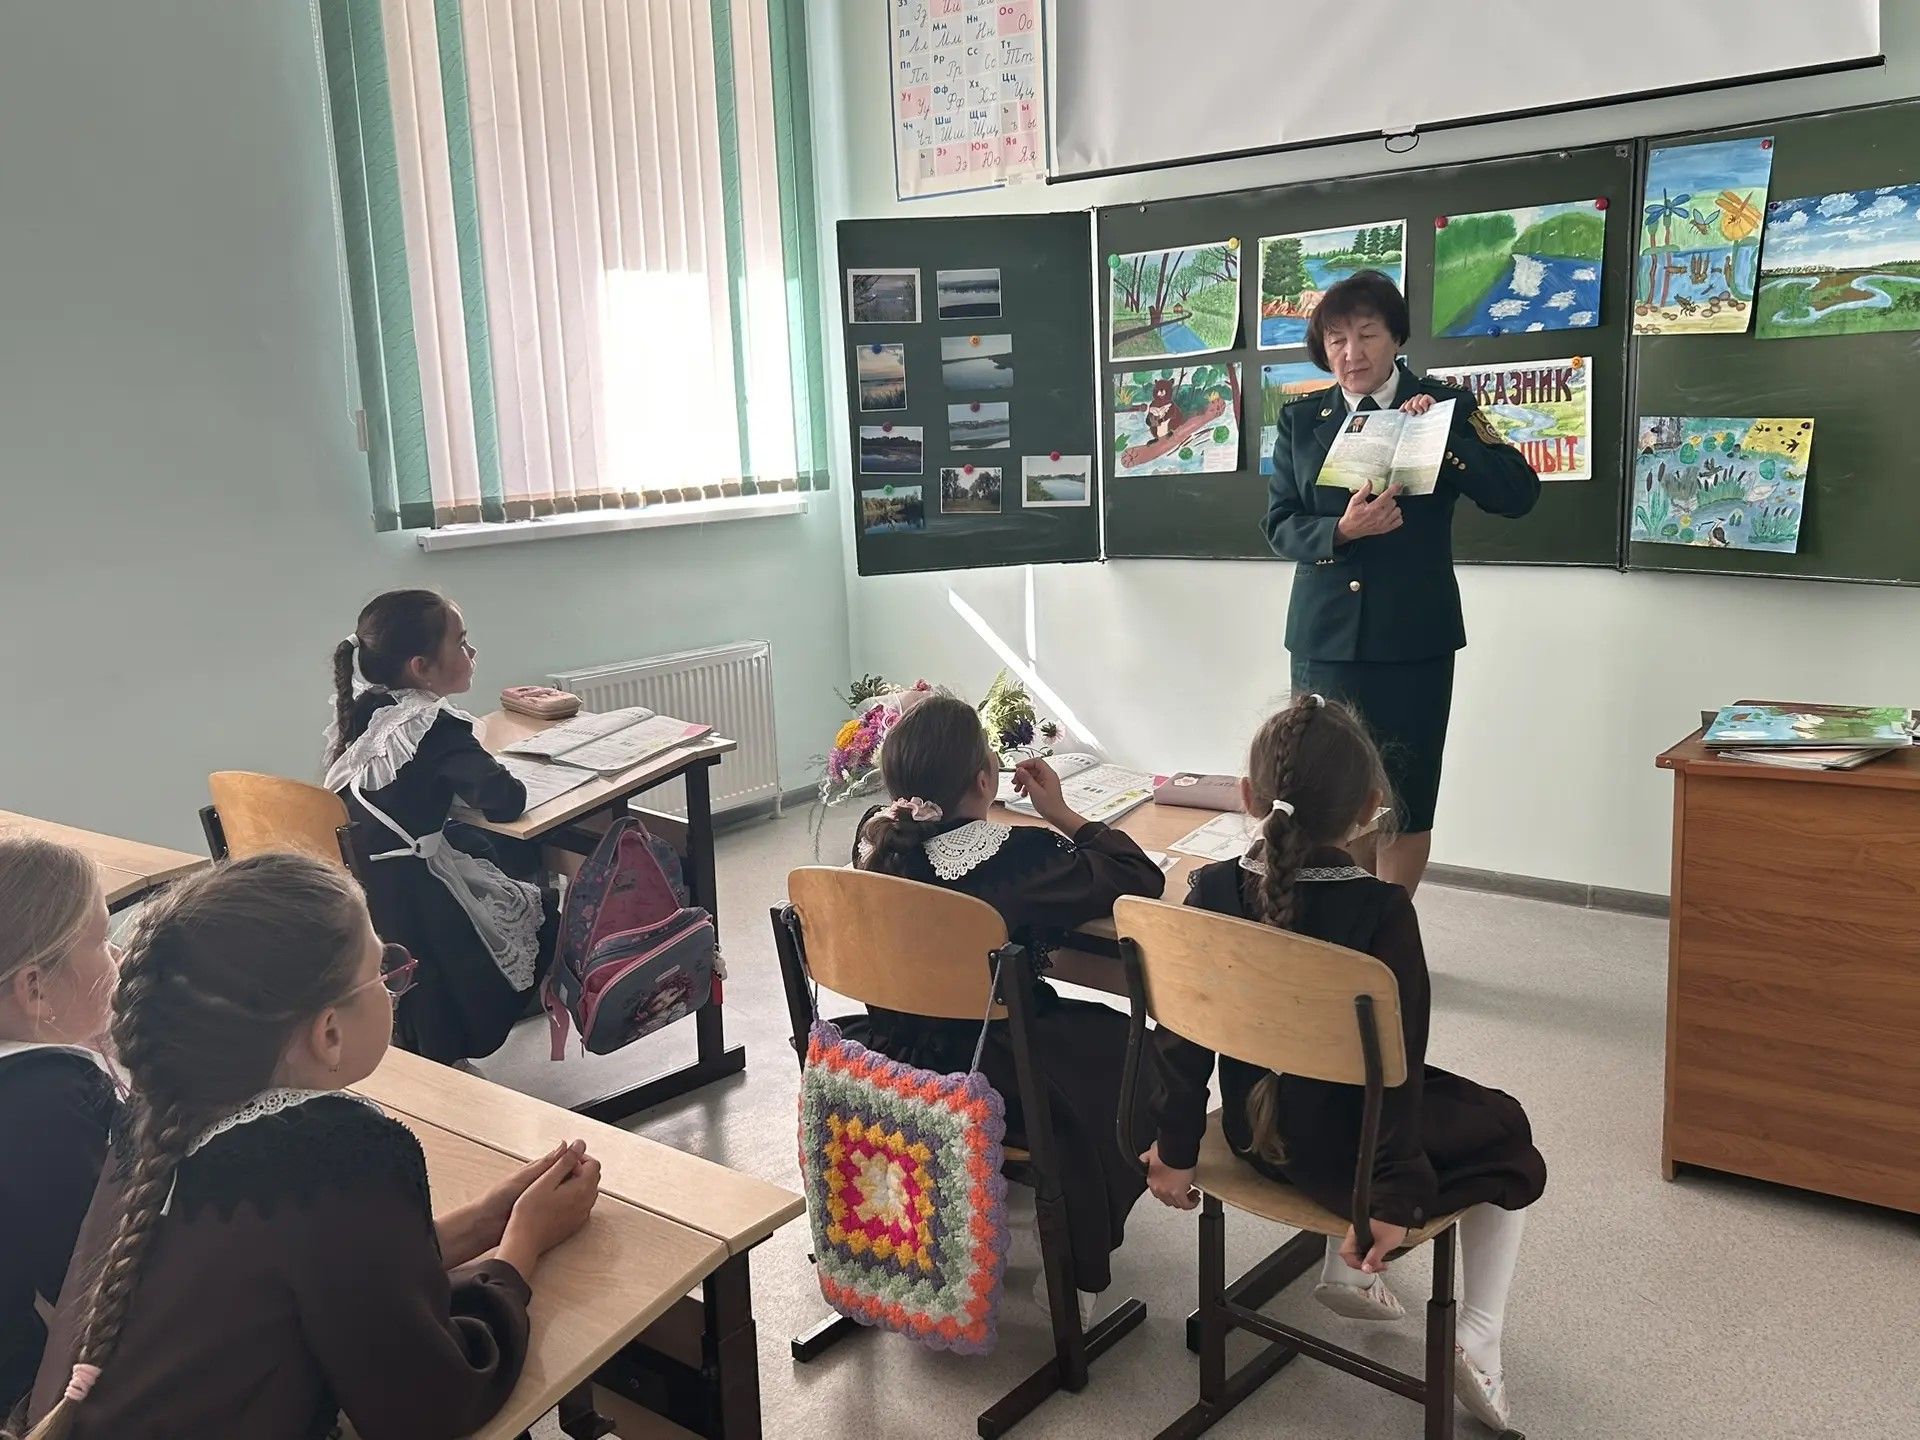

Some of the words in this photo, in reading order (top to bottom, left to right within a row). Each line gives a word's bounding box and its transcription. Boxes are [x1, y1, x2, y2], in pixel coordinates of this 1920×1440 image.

[999, 6, 1014, 16] Оо
[966, 14, 978, 24] Нн
[1018, 13, 1033, 31] Оо
[932, 22, 947, 31] Мм
[1000, 40, 1011, 49] Тт
[967, 47, 978, 56] Сс
[933, 54, 945, 64] Рр
[1002, 72, 1016, 83] Цц
[968, 79, 980, 89] Хх
[933, 84, 949, 95] Фф
[970, 141, 989, 151] Юю
[1005, 136, 1017, 146] Яя
[1508, 435, 1578, 474] ШЫТ
